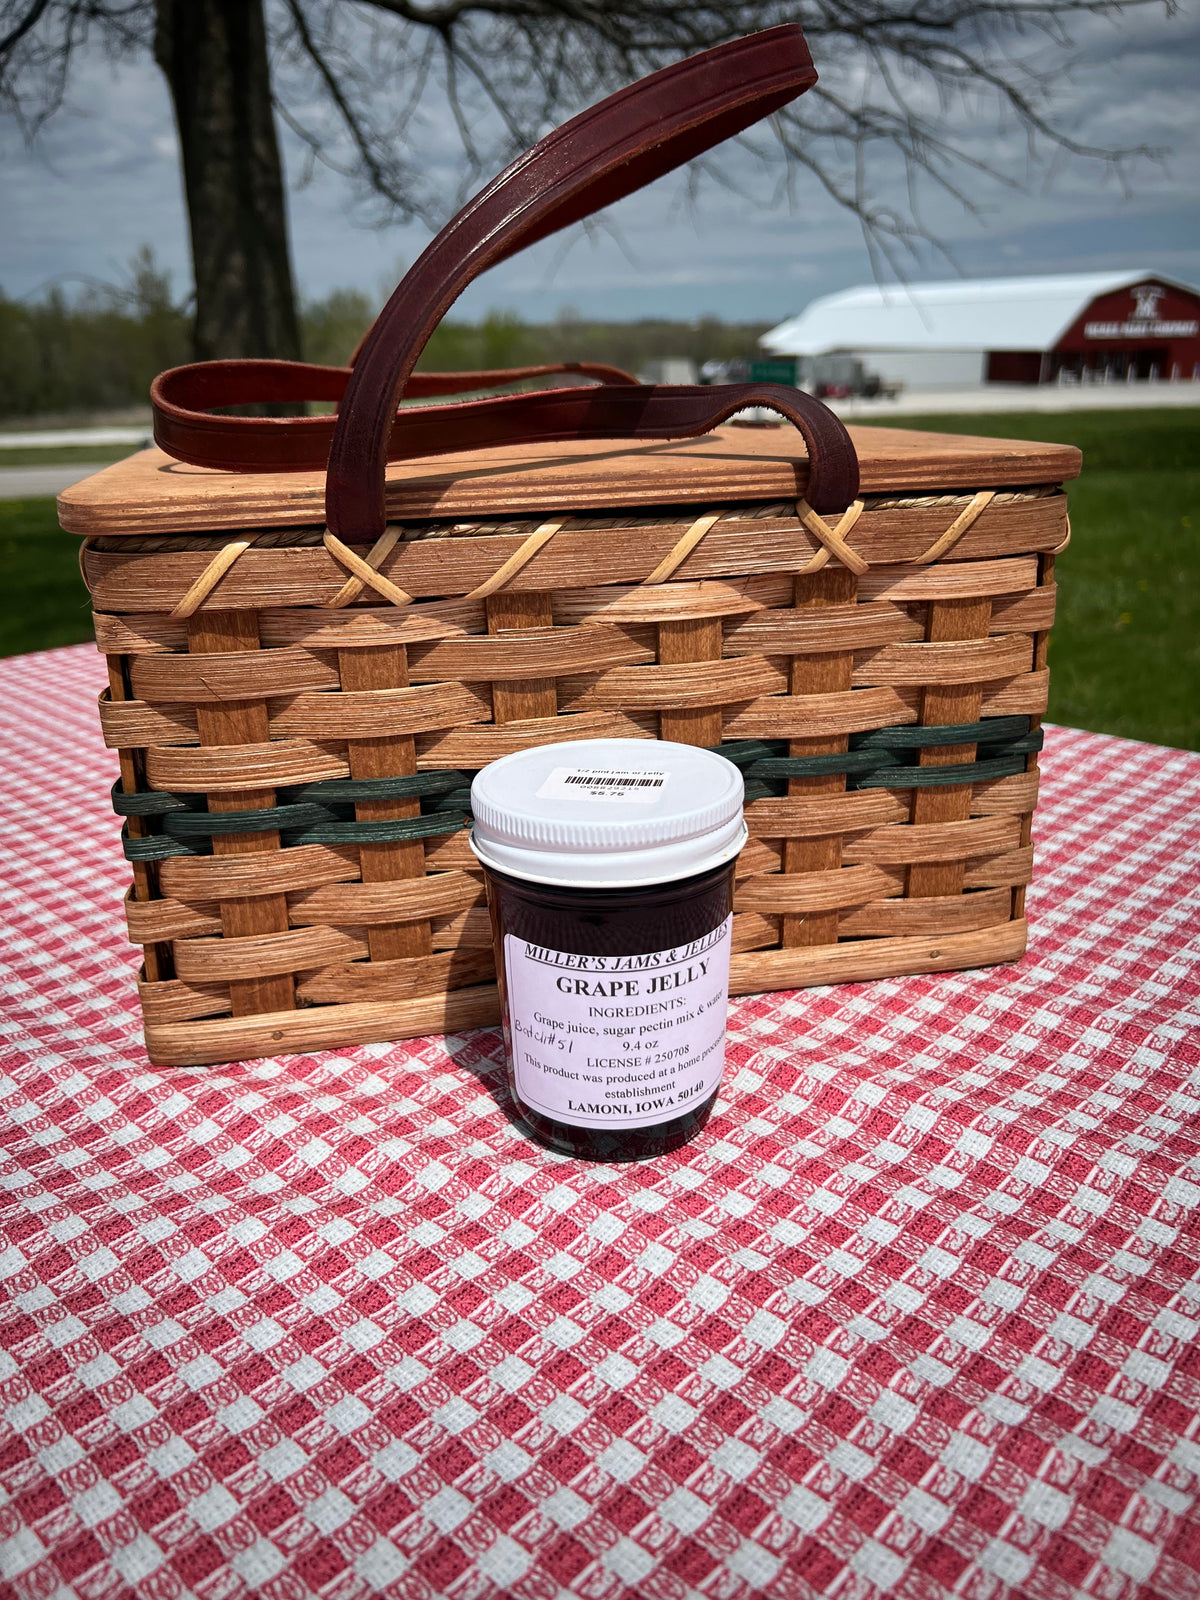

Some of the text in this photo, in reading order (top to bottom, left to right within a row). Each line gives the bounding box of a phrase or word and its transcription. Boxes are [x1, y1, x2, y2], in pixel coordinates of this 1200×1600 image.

[525, 922, 728, 971] MILLER'S JAMS & JELLIES
[556, 957, 710, 997] GRAPE JELLY
[533, 1011, 565, 1030] Grape
[566, 1021, 600, 1037] juice,
[602, 1026, 636, 1038] sugar
[639, 1017, 673, 1036] pectin
[676, 1010, 695, 1025] mix
[697, 1003, 704, 1016] &
[589, 997, 686, 1018] INGREDIENTS:
[587, 1044, 690, 1069] LICENSE # 250708
[622, 1040, 660, 1052] 9.4 oz
[524, 1052, 541, 1069] This
[543, 1064, 580, 1081] product
[582, 1074, 603, 1083] was
[606, 1069, 656, 1086] produced
[658, 1068, 668, 1078] at
[670, 1067, 676, 1075] a
[678, 1054, 701, 1072] home
[567, 1079, 704, 1116] LAMONI, IOWA 50140
[604, 1081, 676, 1099] establishment
